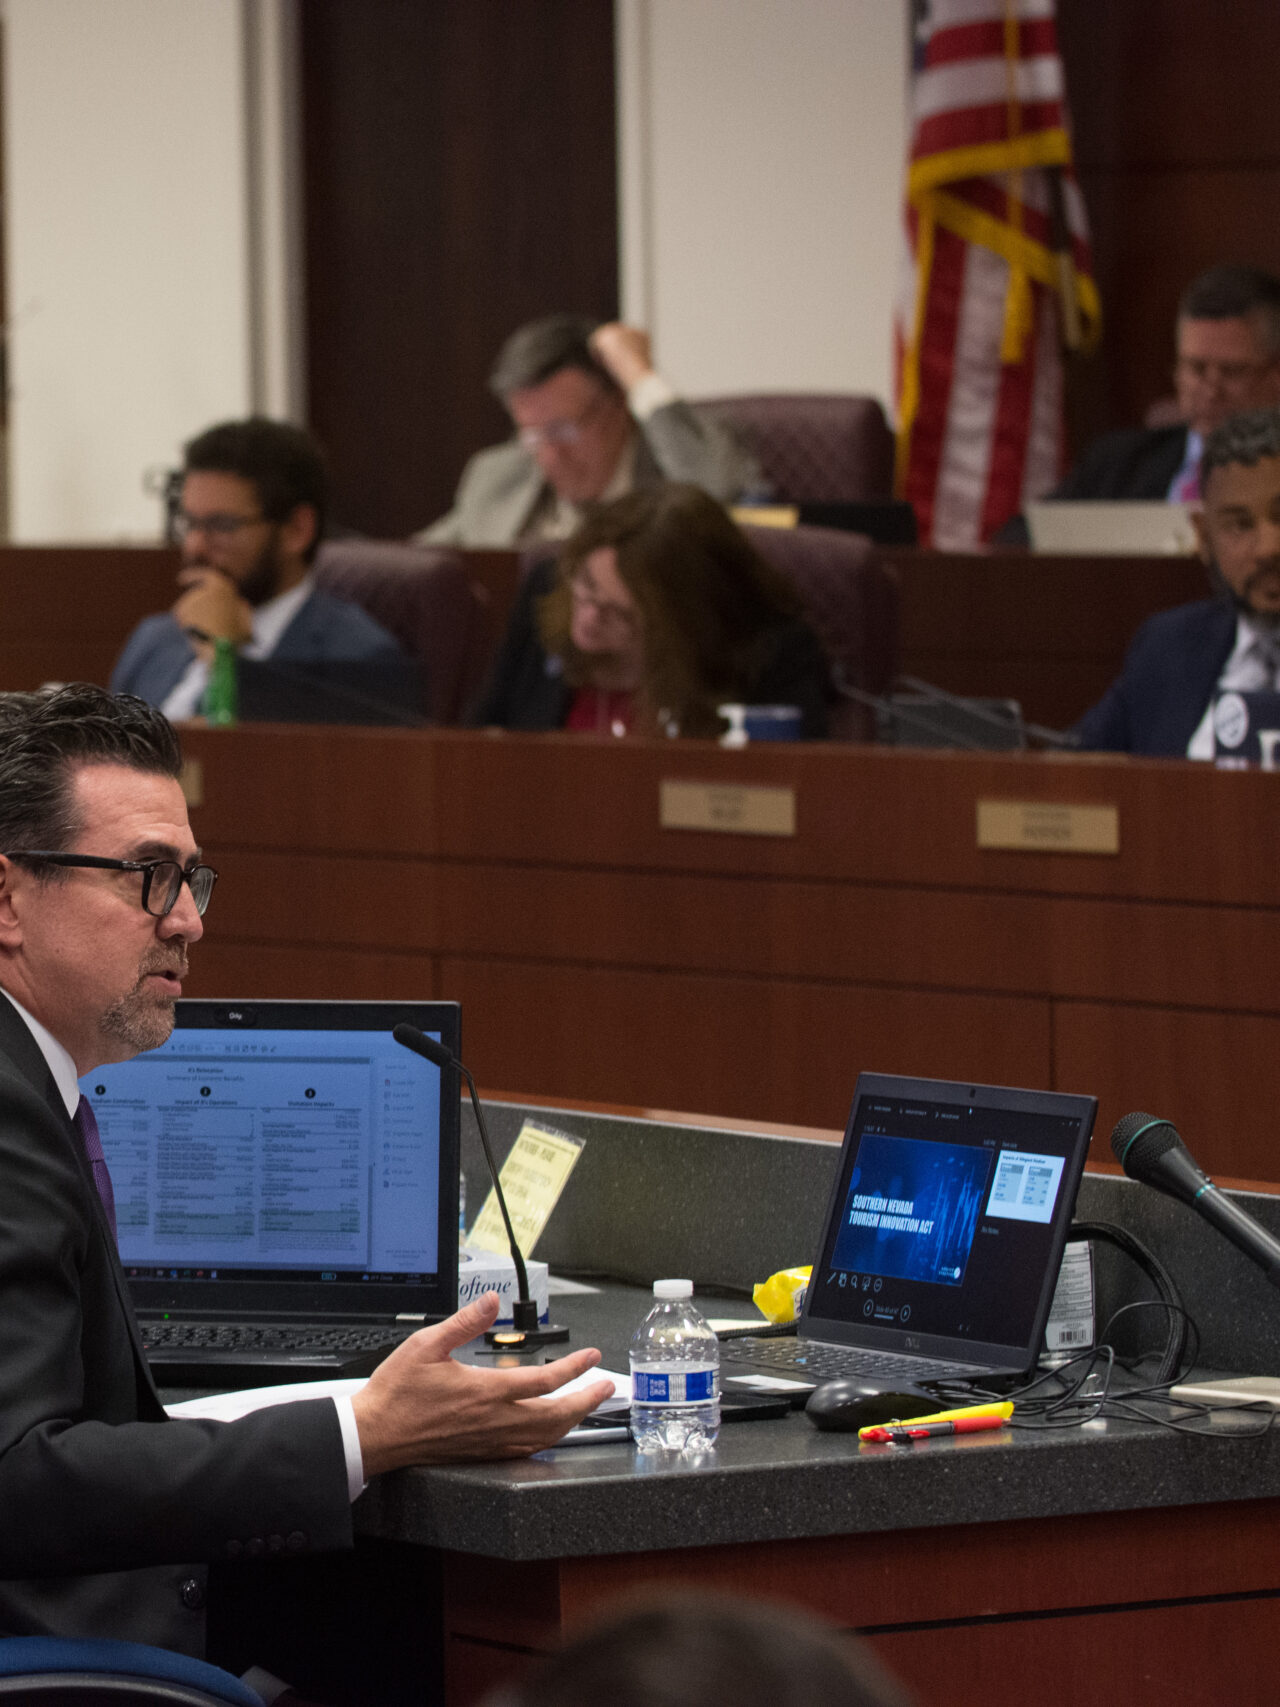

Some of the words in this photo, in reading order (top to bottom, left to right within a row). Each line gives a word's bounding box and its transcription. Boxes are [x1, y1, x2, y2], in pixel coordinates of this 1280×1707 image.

[852, 1194, 888, 1213] SOUTHERN
[886, 1199, 914, 1215] NEVADA
[849, 1211, 881, 1228] TOURISM
[879, 1214, 921, 1233] INNOVATION
[918, 1219, 934, 1235] ACT
[459, 1275, 511, 1301] oftone
